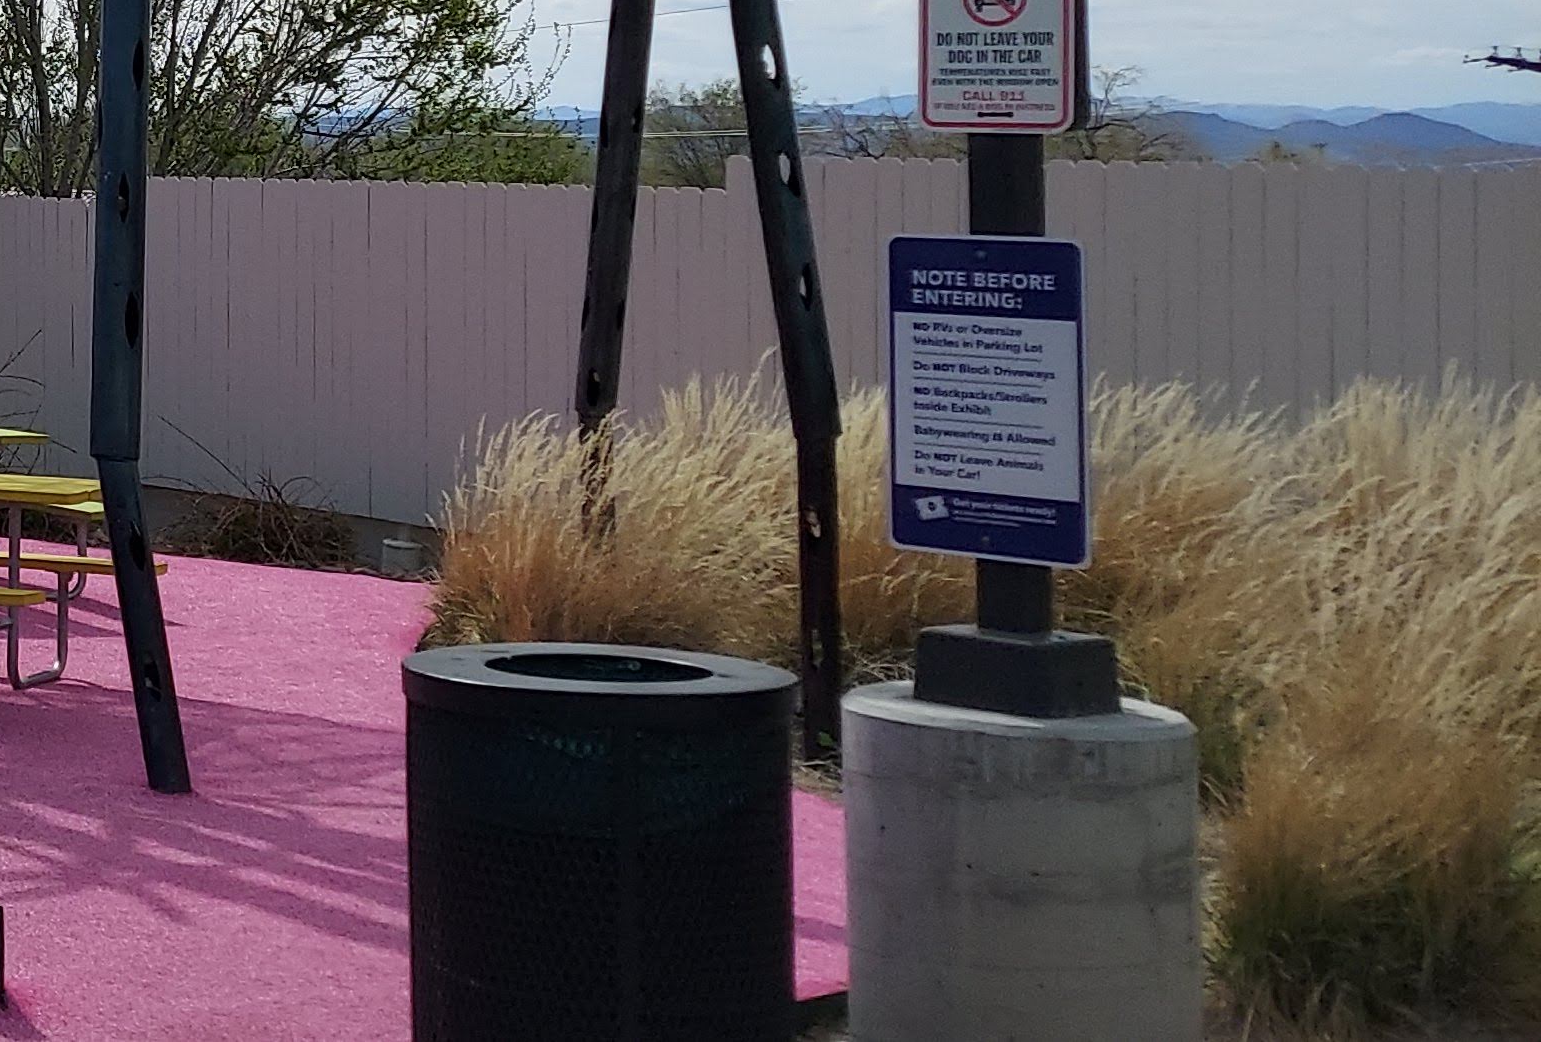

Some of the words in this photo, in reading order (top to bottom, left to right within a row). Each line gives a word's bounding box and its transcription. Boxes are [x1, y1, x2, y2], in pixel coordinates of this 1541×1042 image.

[937, 32, 953, 47] DO
[957, 32, 979, 47] NOT
[983, 31, 1018, 47] LEAVE
[1023, 31, 1054, 47] YOUR
[948, 49, 973, 64] DOG
[977, 49, 988, 64] IN
[992, 49, 1014, 64] THE
[1018, 49, 1042, 64] CAR
[963, 91, 993, 102] CALL
[1000, 90, 1025, 102] 911
[912, 270, 967, 286] NOTE
[973, 273, 1057, 290] BEFORE
[912, 289, 1023, 309] ENTERING:
[913, 322, 930, 332] NO
[933, 322, 953, 333] RVs
[956, 325, 968, 334] or
[971, 324, 1023, 336] Oversize
[914, 335, 960, 348] Vehicles
[976, 339, 1021, 355] Parking
[1024, 343, 1044, 354] Lot
[913, 361, 931, 371] Do
[933, 363, 956, 374] NOT
[959, 363, 991, 375] Block
[994, 366, 1056, 381] Driveways
[914, 386, 931, 395] NO
[951, 403, 992, 416] Exhibit
[914, 425, 990, 443] Babywearing
[1006, 433, 1056, 446] Allowed
[915, 450, 931, 460] Do
[934, 452, 958, 463] NOT
[960, 454, 994, 466] Leave
[997, 458, 1045, 471] Animals
[928, 466, 955, 477] Your
[957, 469, 981, 480] Car!
